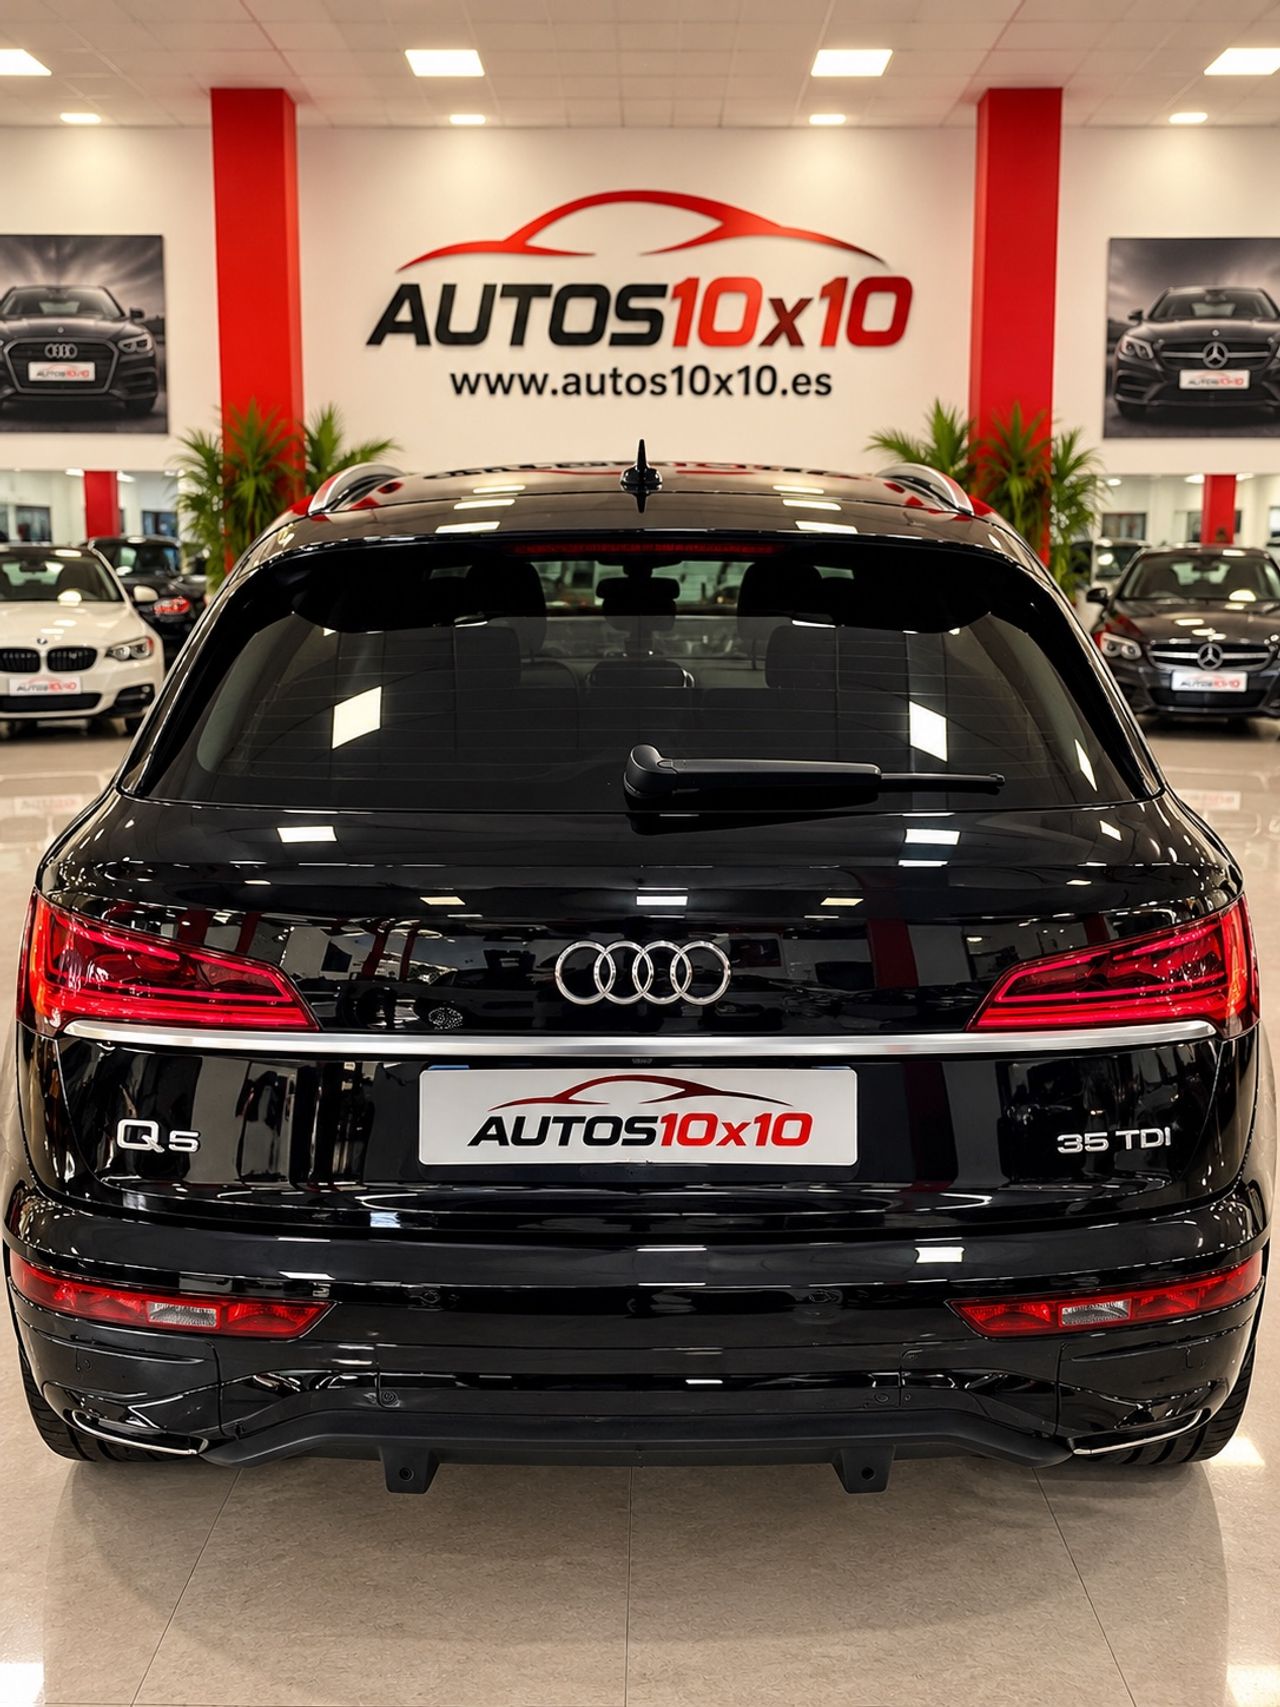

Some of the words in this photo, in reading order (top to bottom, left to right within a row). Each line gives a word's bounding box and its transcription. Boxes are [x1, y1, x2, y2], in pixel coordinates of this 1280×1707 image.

[366, 277, 913, 348] AUTOS10x10
[450, 365, 833, 396] www.autos10x10.es
[117, 1119, 199, 1153] Q5
[467, 1112, 813, 1147] AUTOS10x10
[1057, 1132, 1109, 1153] 35
[1115, 1126, 1171, 1150] TDI
